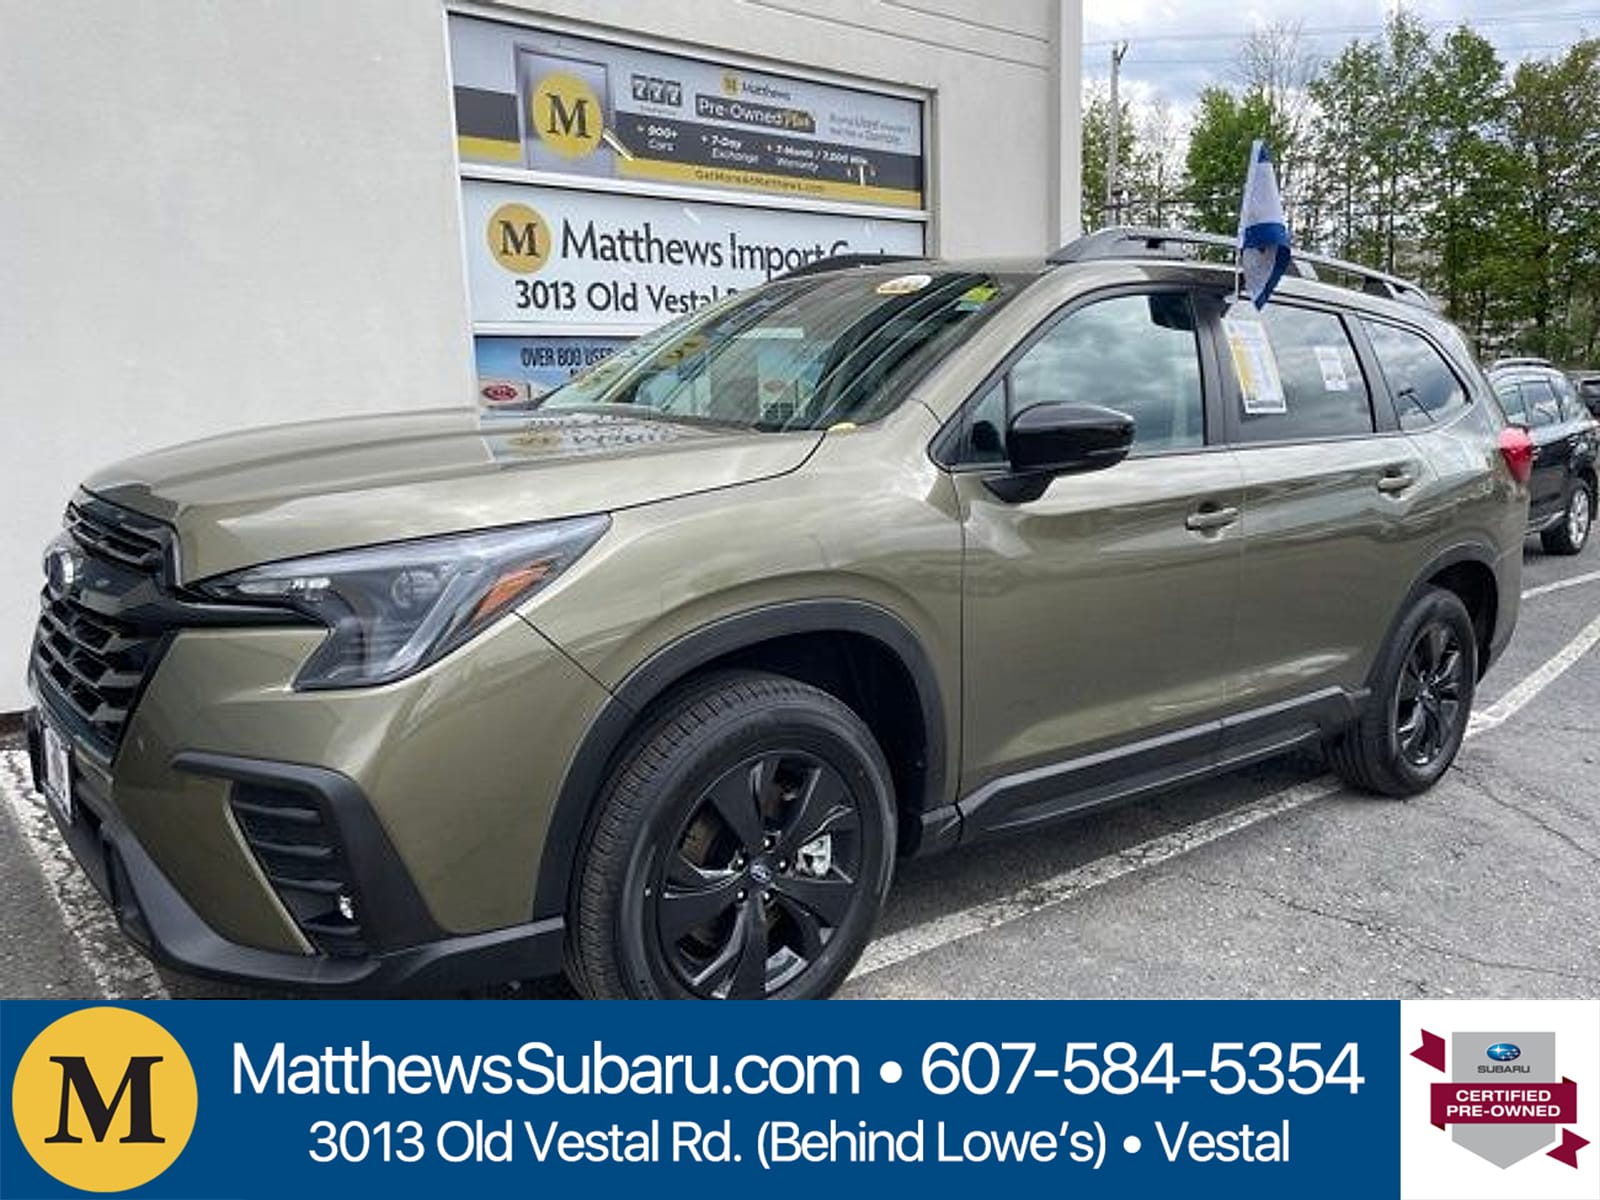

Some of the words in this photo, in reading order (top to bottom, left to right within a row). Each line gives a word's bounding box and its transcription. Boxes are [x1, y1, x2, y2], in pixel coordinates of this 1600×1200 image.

[546, 92, 591, 139] M
[499, 219, 541, 258] M
[561, 217, 723, 268] Matthews
[729, 232, 826, 282] Import
[515, 280, 575, 312] 3013
[586, 282, 638, 312] Old
[520, 346, 554, 367] OVER
